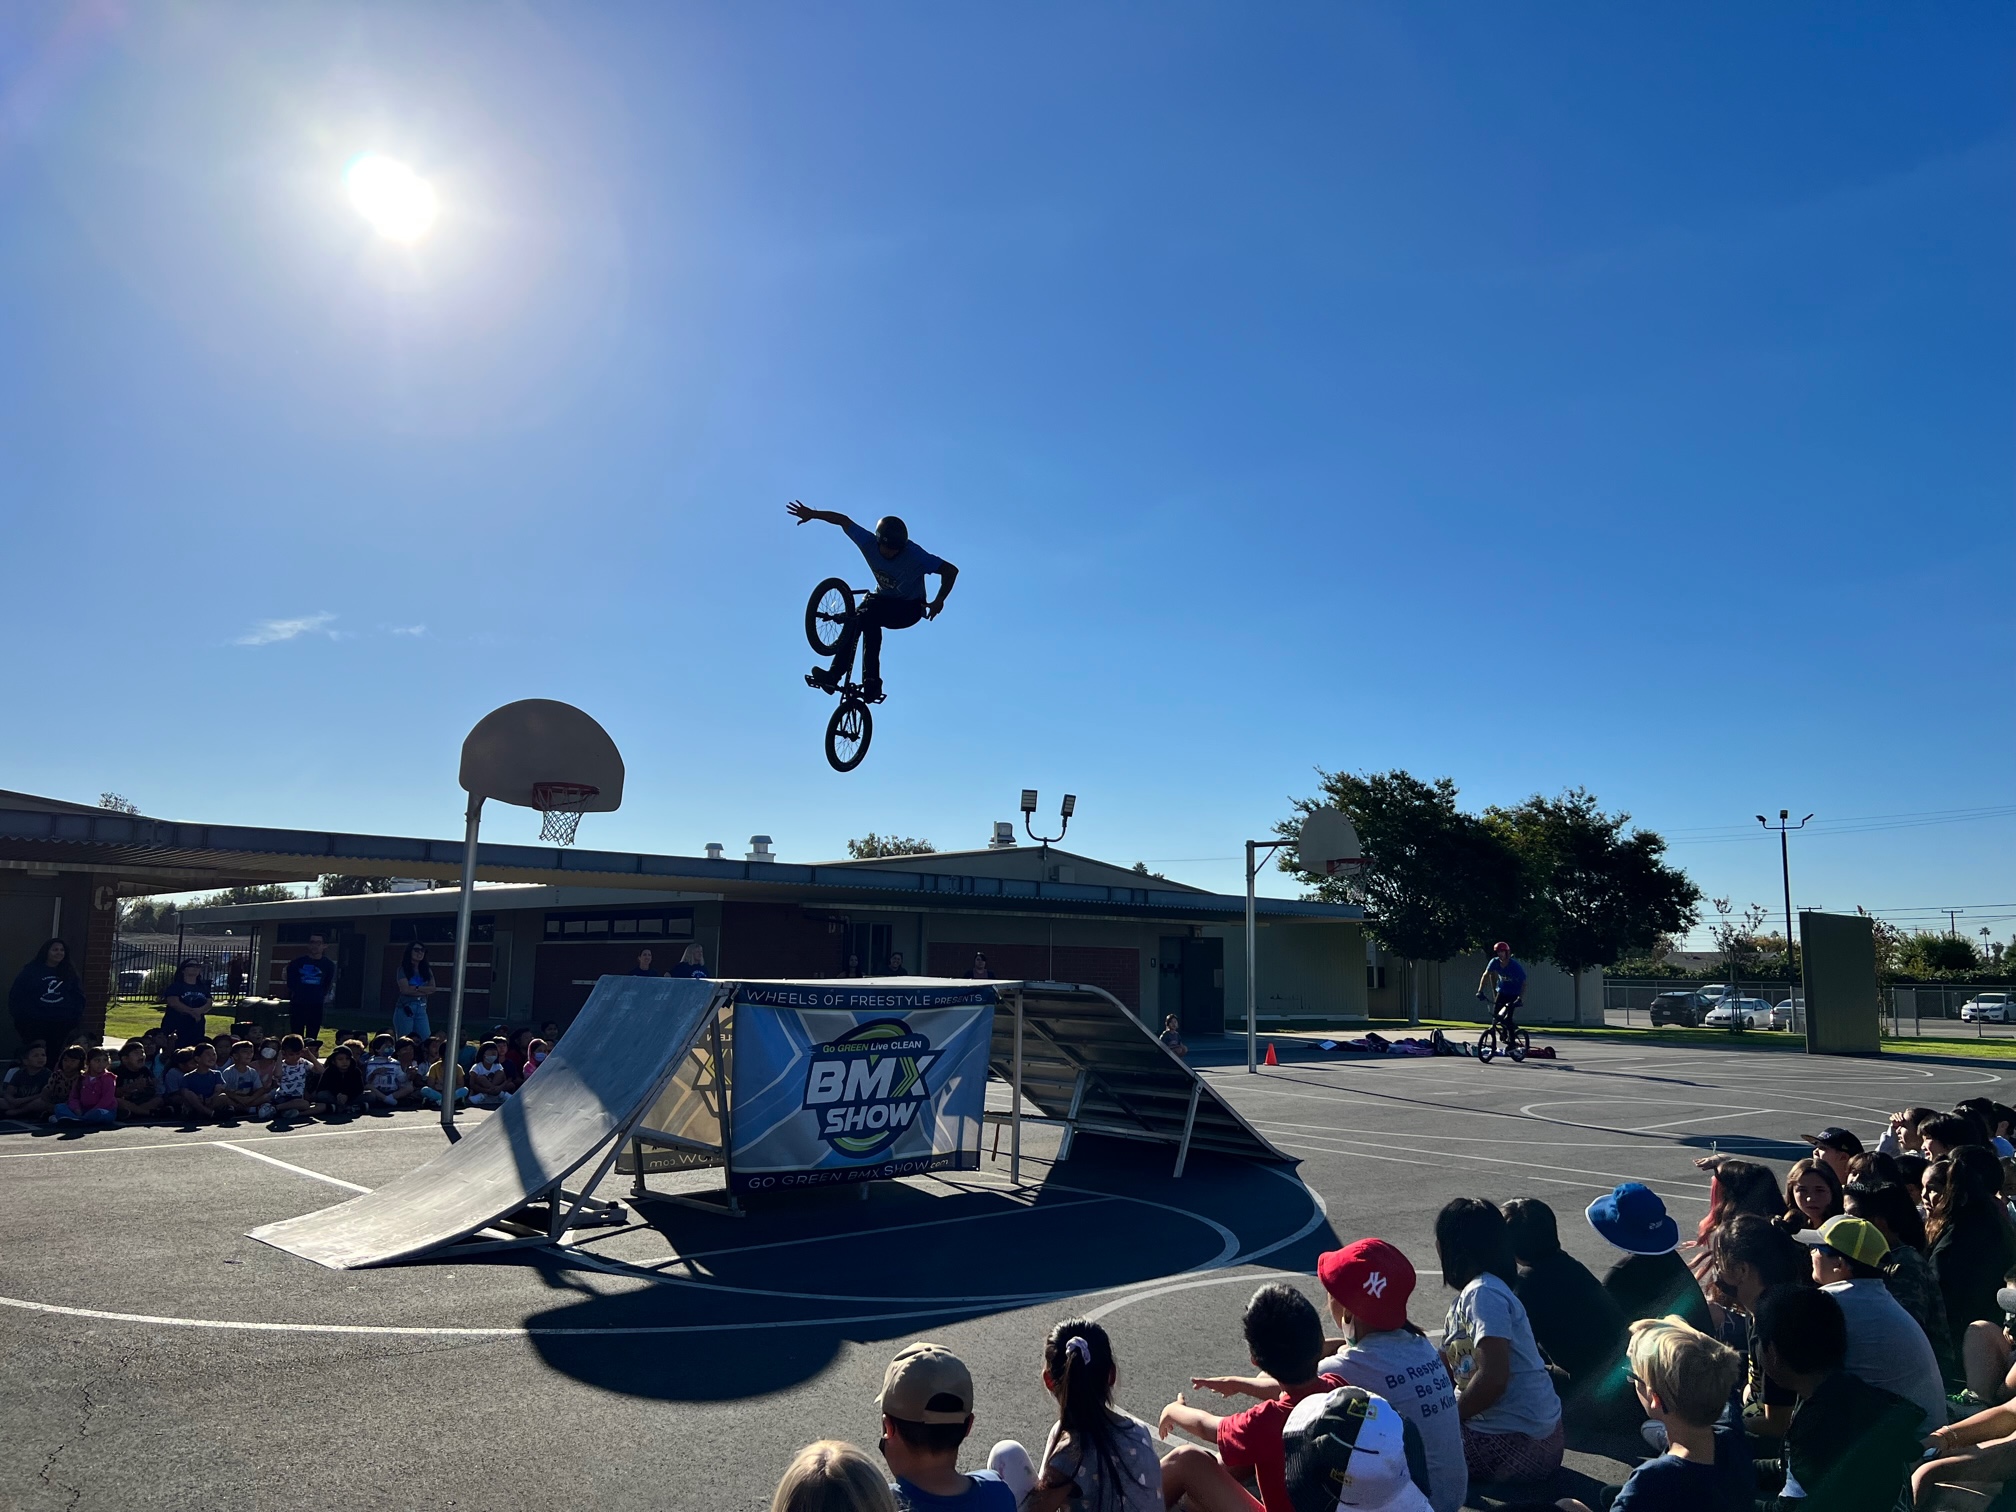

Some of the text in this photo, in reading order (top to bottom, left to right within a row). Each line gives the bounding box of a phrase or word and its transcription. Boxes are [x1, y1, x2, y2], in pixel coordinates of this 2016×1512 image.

[95, 886, 114, 911] C
[747, 989, 983, 1007] WHEELS OF FREESTYLE PRESENTS
[822, 1040, 922, 1053] Go GREEN Live CLEAN
[806, 1054, 936, 1105] BMX
[824, 1101, 917, 1133] SHOW
[748, 1177, 776, 1189] GO
[781, 1172, 842, 1185] GREEN
[847, 1168, 880, 1180] BMX
[1384, 1373, 1406, 1389] Be
[1415, 1384, 1433, 1398] Be
[1420, 1403, 1439, 1418] Be
